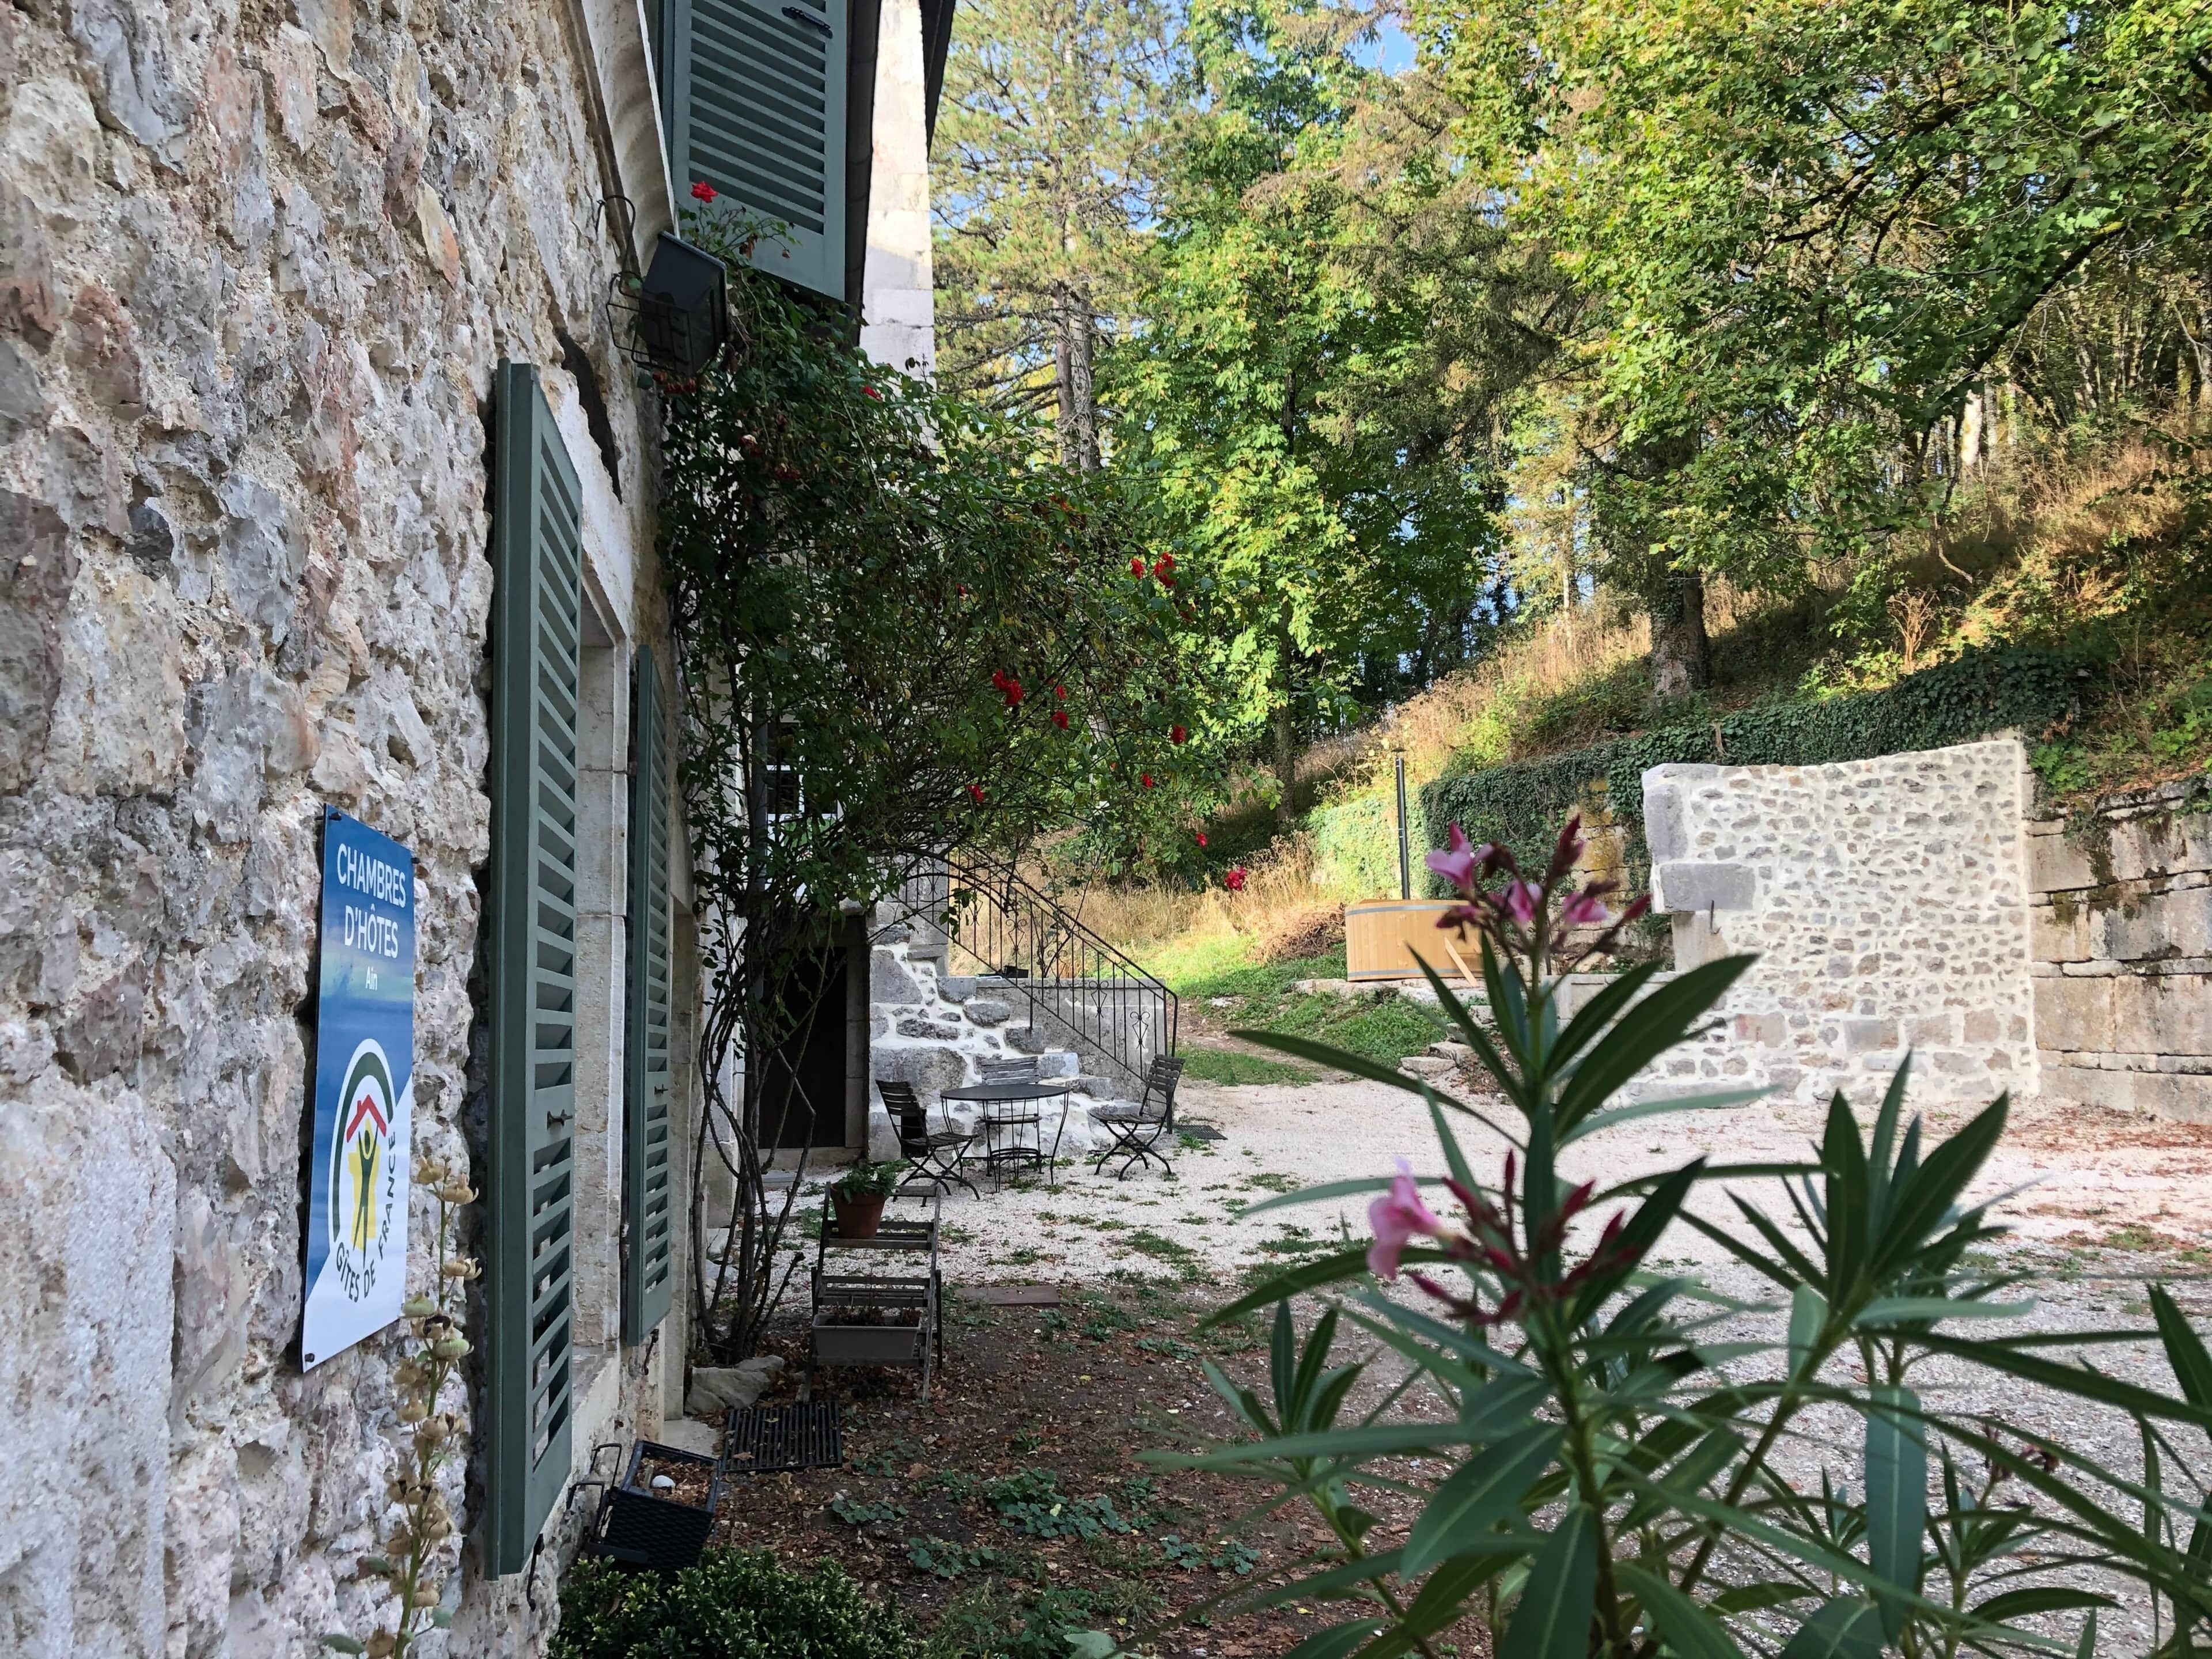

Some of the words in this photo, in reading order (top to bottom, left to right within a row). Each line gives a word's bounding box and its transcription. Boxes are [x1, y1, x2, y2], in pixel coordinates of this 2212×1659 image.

[337, 843, 406, 908] CHAMBRES
[344, 904, 398, 959] D'HÔTES
[365, 966, 378, 990] Ain
[336, 1242, 359, 1302] GÎTES
[363, 1259, 376, 1298] DE
[378, 1131, 396, 1260] FRANCE
